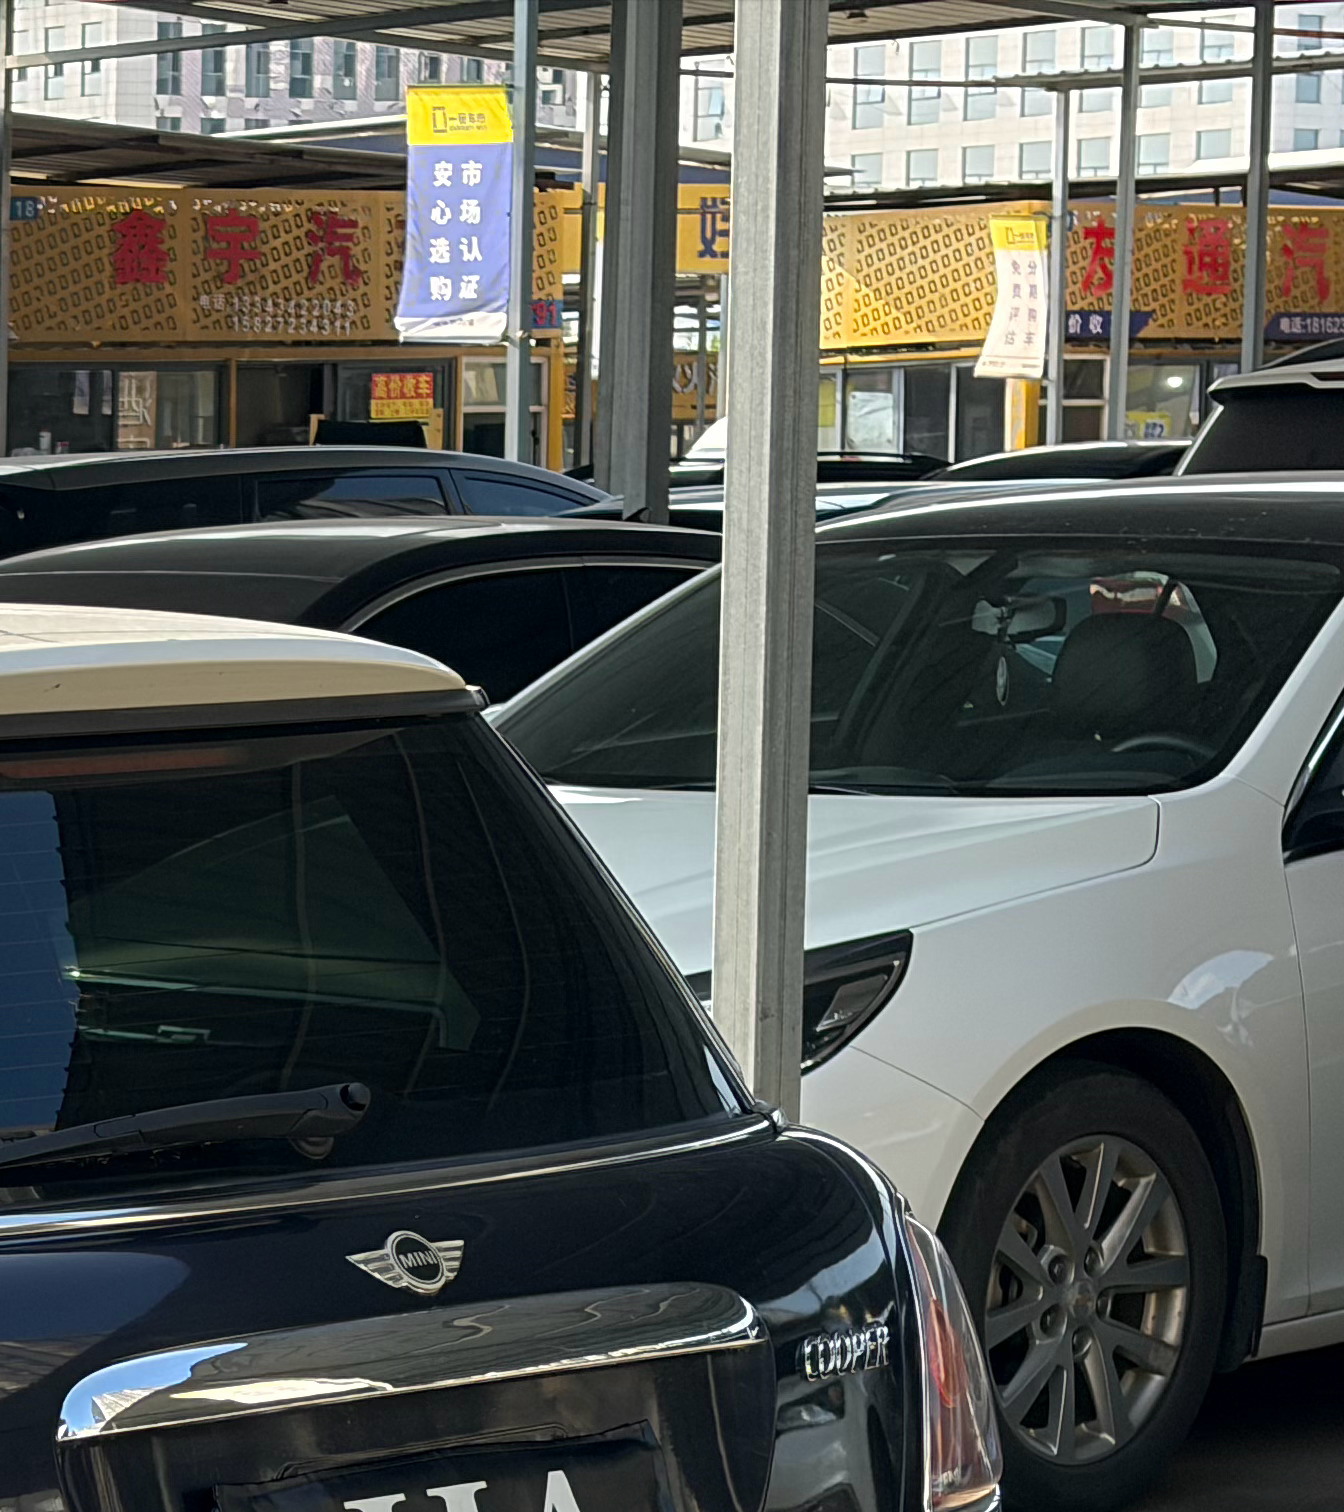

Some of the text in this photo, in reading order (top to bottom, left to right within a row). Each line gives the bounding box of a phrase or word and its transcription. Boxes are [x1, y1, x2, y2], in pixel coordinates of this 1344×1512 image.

[15, 200, 35, 218] 18
[429, 160, 453, 301] 安心选购
[459, 160, 483, 299] 市场认证
[112, 208, 408, 286] 鑫宇汽
[398, 1250, 438, 1269] MINI
[804, 1326, 890, 1382] COOPER
